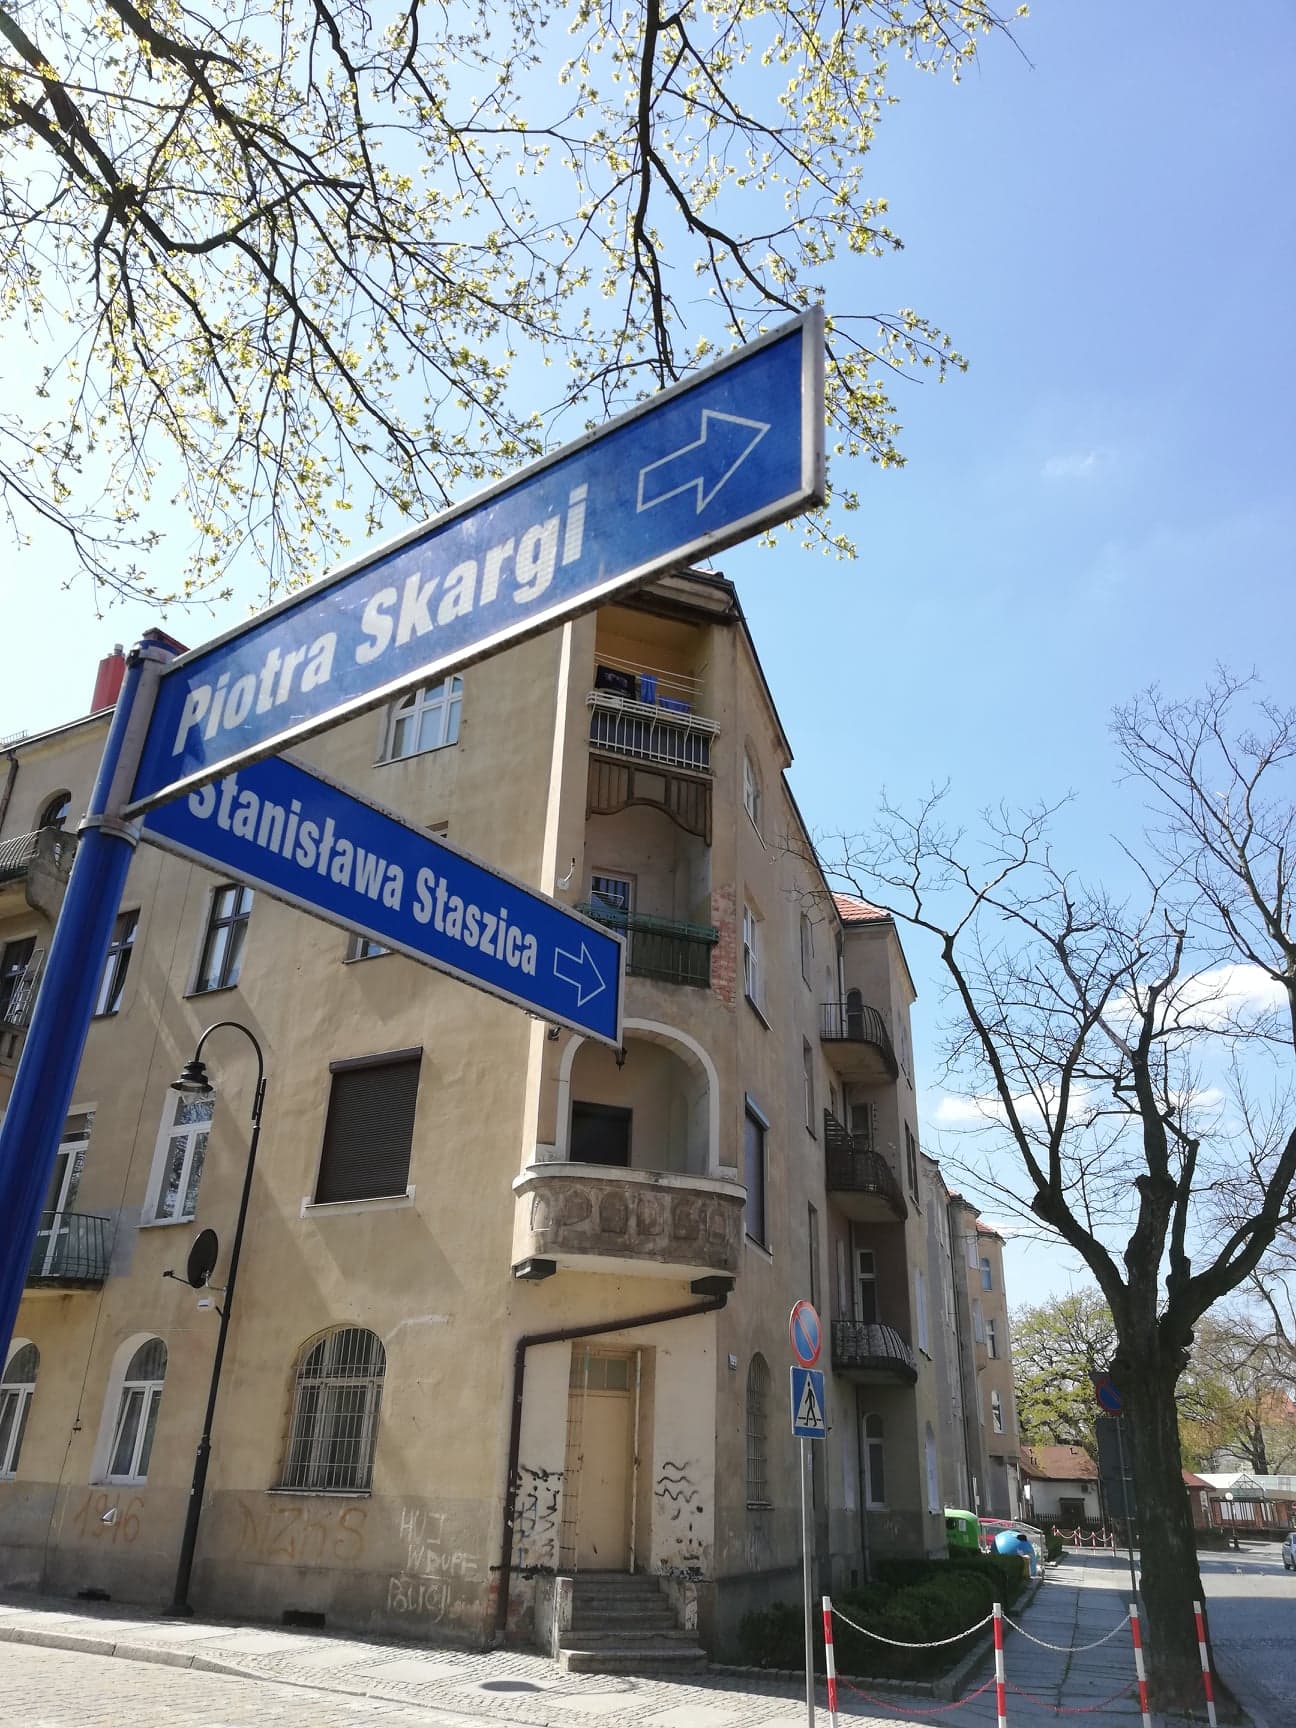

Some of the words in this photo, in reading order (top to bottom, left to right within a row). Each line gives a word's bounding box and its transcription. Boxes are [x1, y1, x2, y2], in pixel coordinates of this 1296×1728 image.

[172, 631, 337, 757] Piotra
[355, 483, 588, 667] Skargi
[412, 866, 538, 977] Staszica
